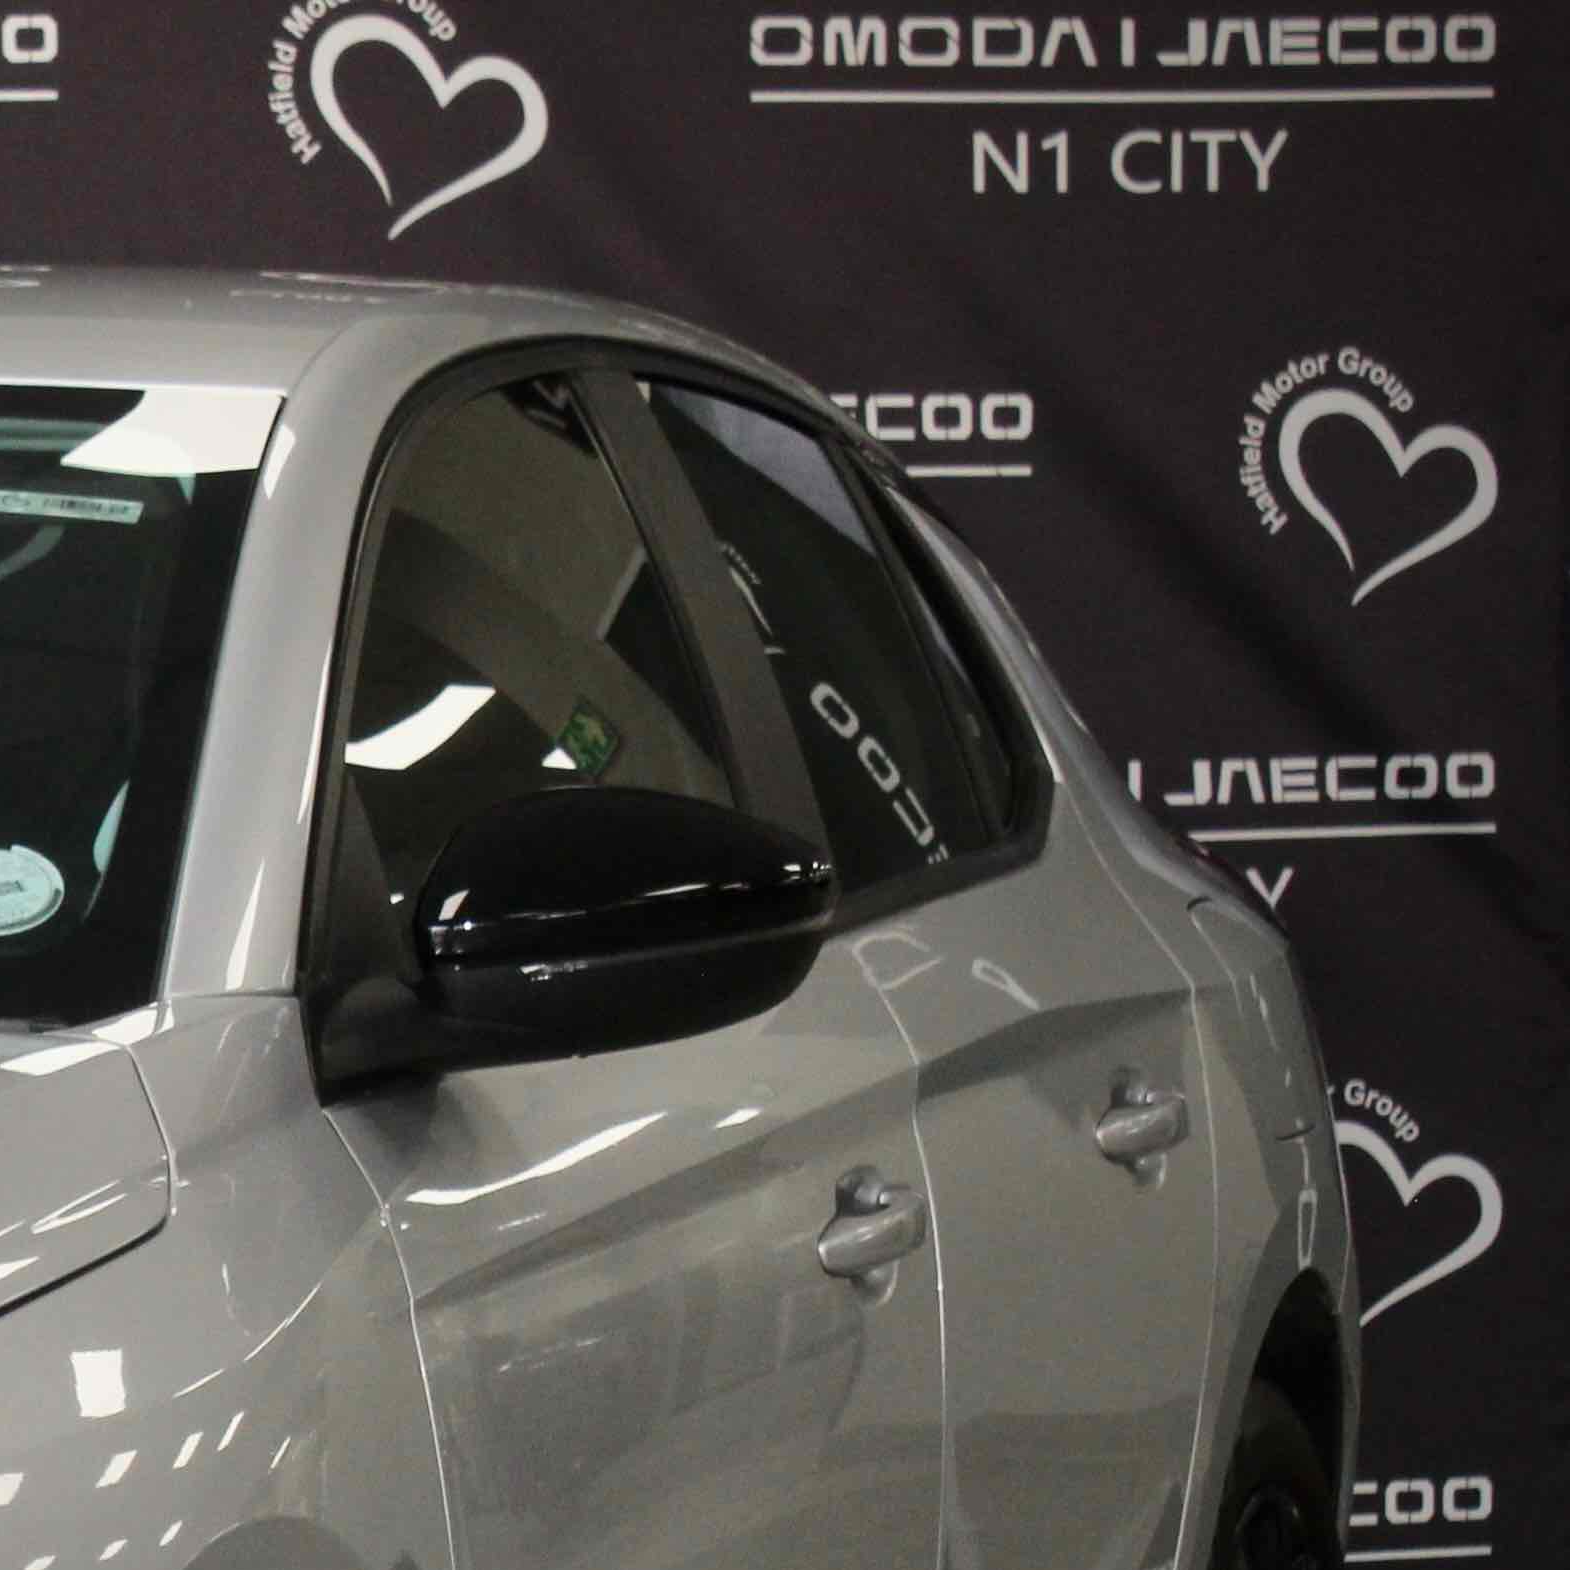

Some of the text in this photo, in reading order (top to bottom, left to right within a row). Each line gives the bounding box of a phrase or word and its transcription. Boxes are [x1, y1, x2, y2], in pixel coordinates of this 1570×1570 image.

[750, 16, 1097, 67] OMODA
[1156, 16, 1496, 67] JAECOO
[267, 39, 322, 165] Hatfield
[972, 130, 1288, 194] N1 CITY
[829, 393, 1034, 441] COO
[1239, 345, 1416, 535] Hatfield Motor Group
[1164, 753, 1495, 806] JAECOO
[1343, 1077, 1420, 1143] Group
